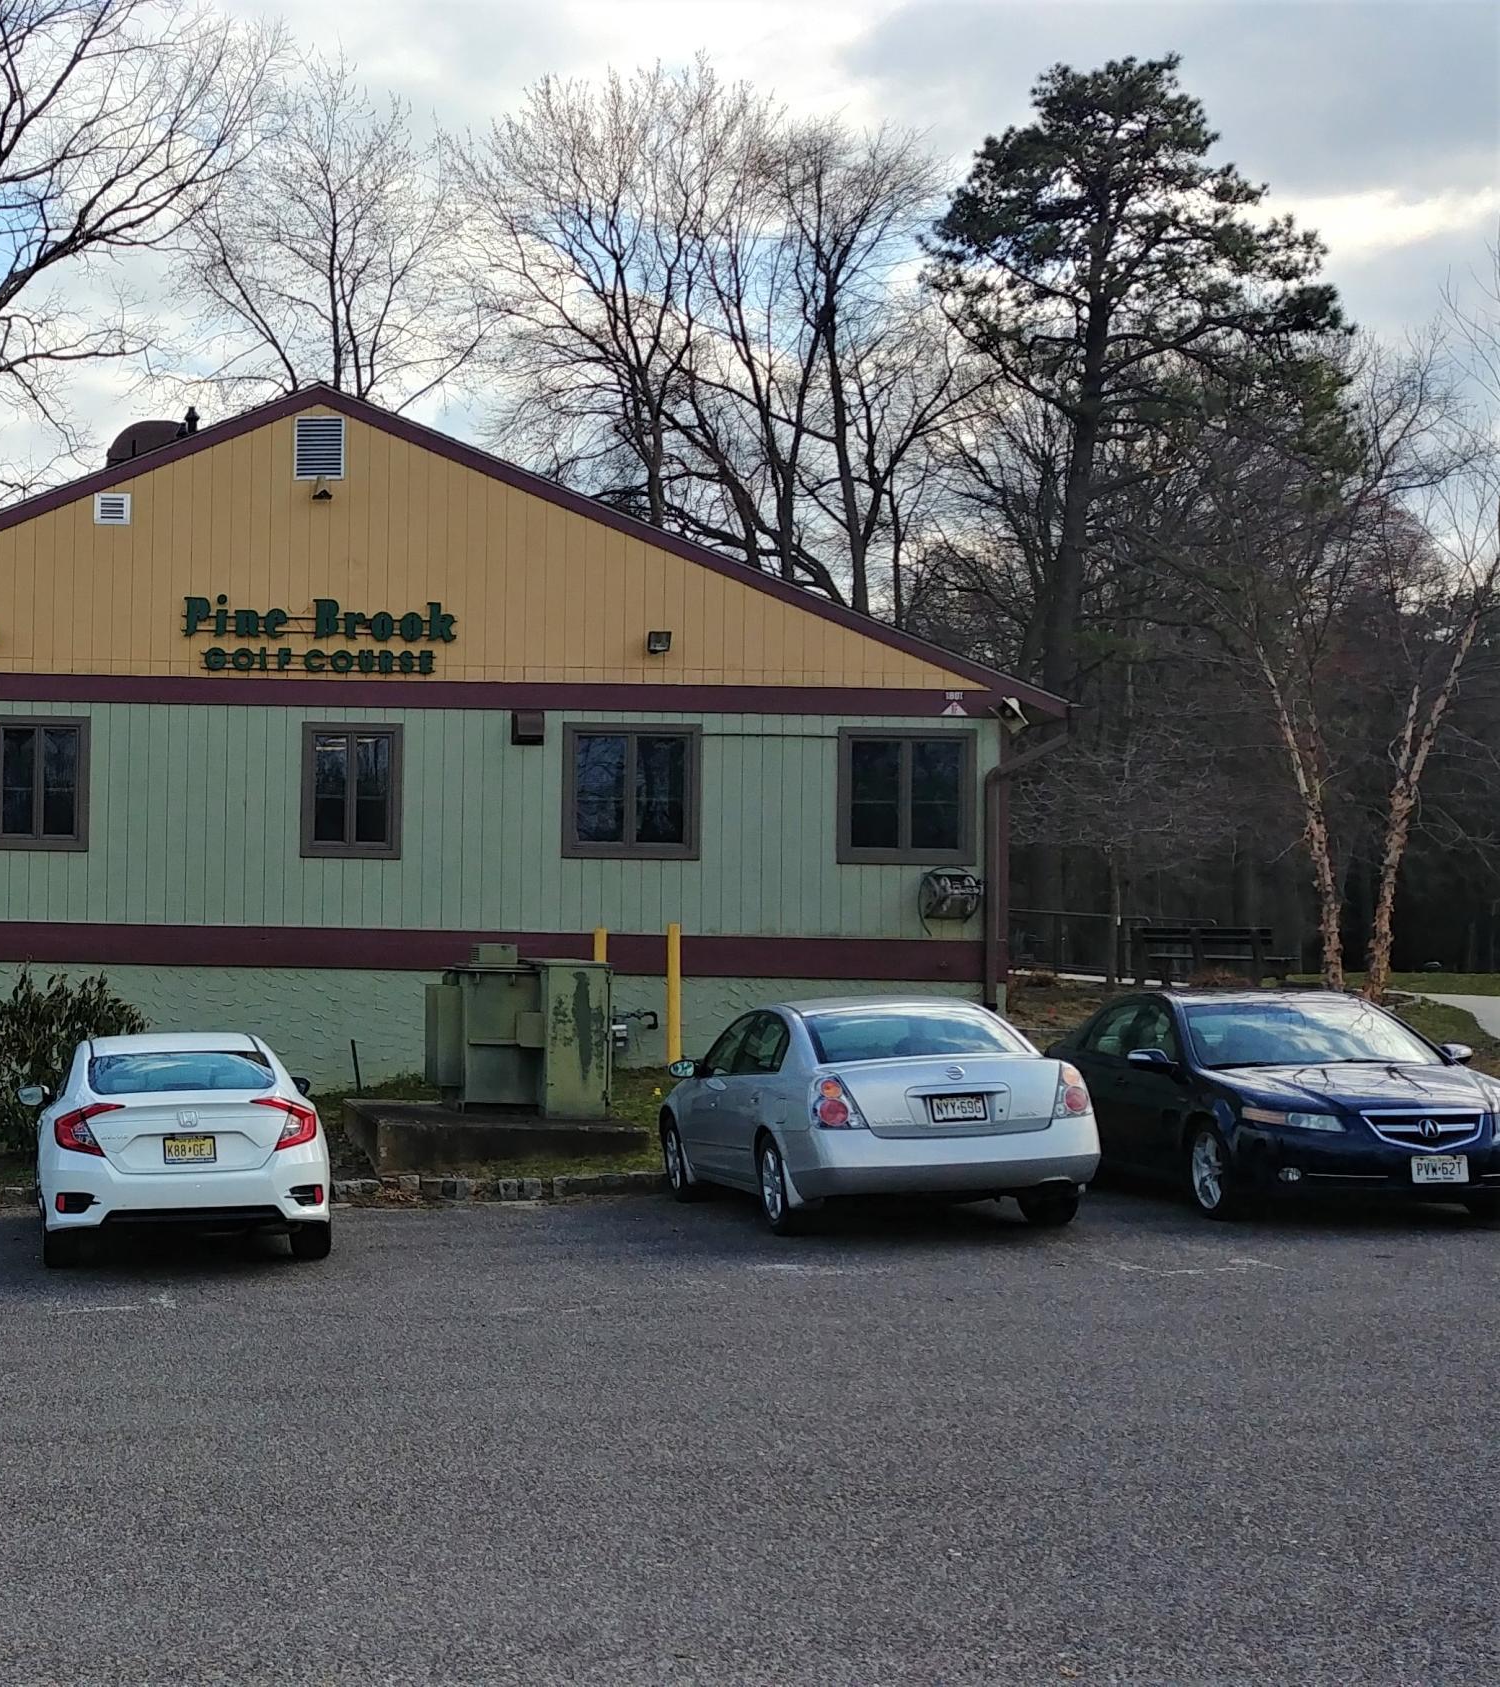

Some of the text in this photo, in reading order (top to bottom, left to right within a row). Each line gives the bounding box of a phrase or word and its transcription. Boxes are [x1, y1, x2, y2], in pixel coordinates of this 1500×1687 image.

[184, 594, 457, 642] Pine Brook
[205, 646, 434, 674] GOLF COURSE
